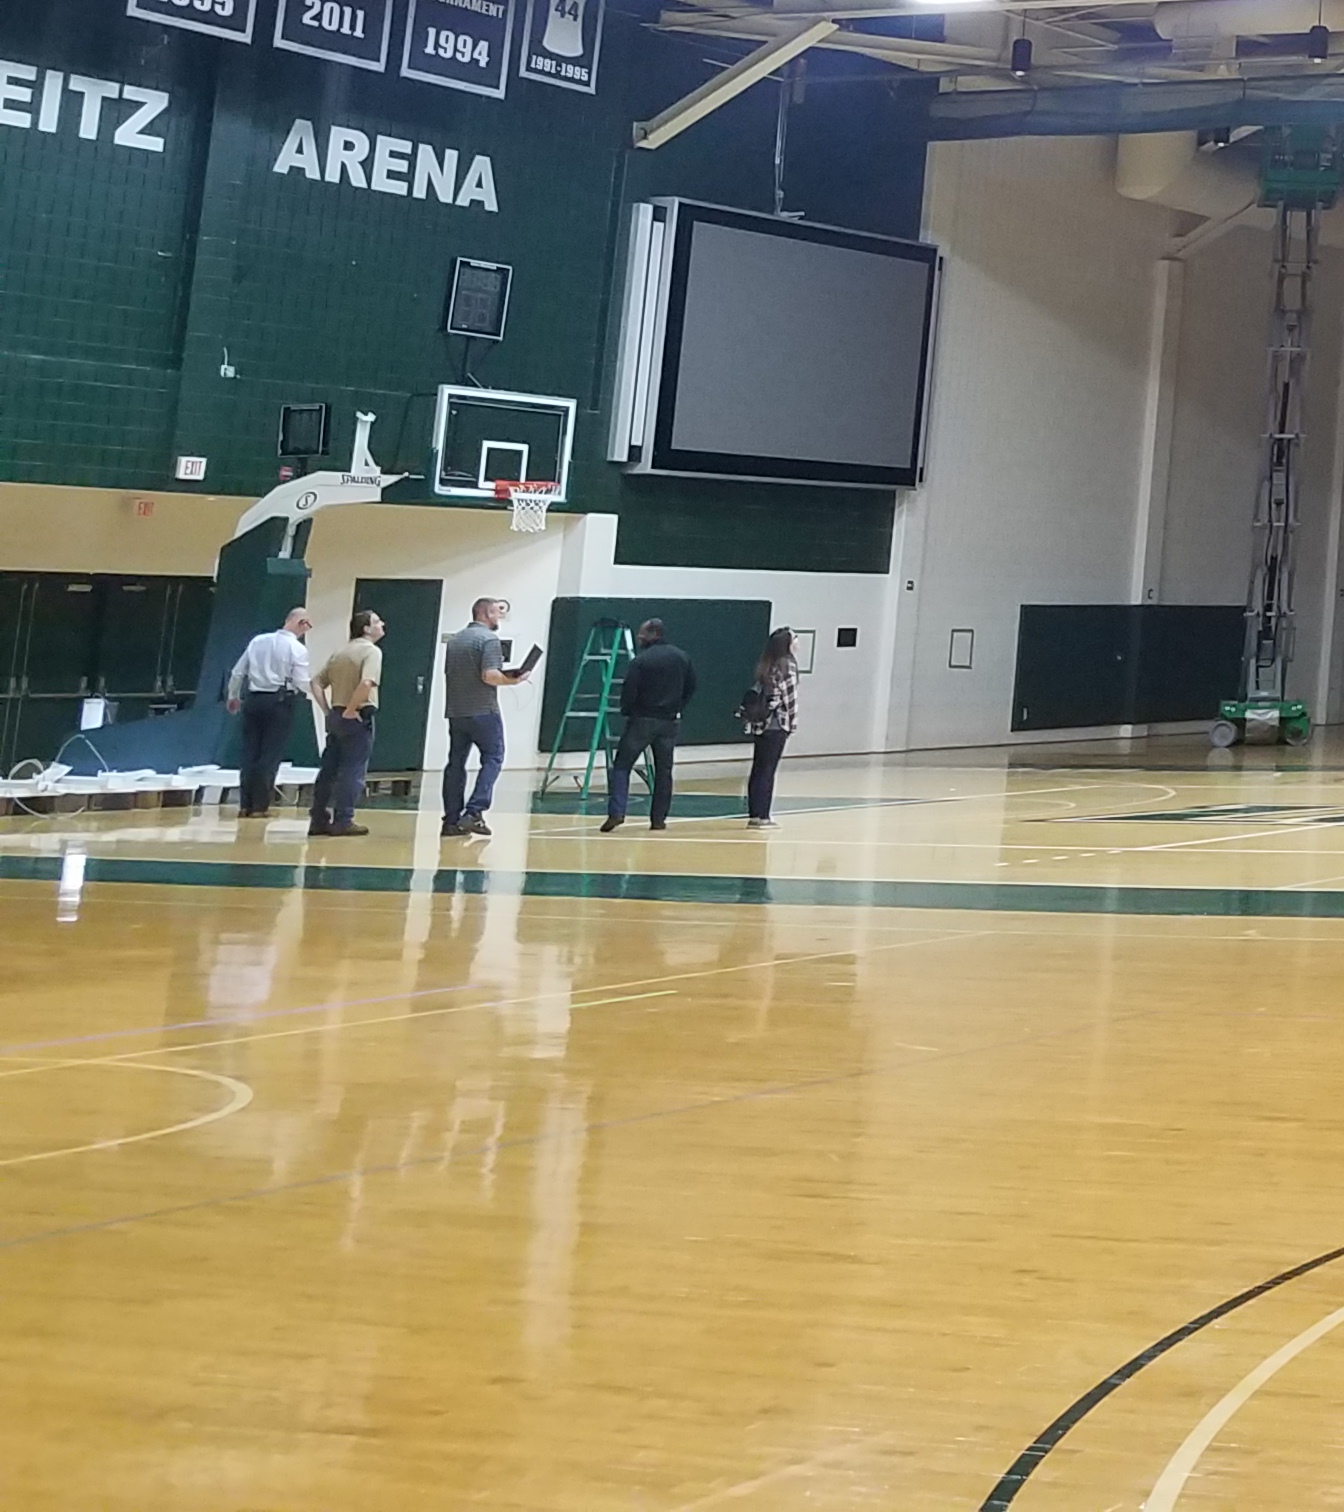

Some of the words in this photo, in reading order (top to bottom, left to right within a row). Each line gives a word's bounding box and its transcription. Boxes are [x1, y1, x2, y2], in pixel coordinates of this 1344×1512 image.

[423, 27, 490, 68] 1994
[530, 54, 589, 82] 1991-1995
[272, 117, 500, 214] ARENA
[184, 460, 203, 476] EXIT
[340, 474, 382, 486] SPALDING
